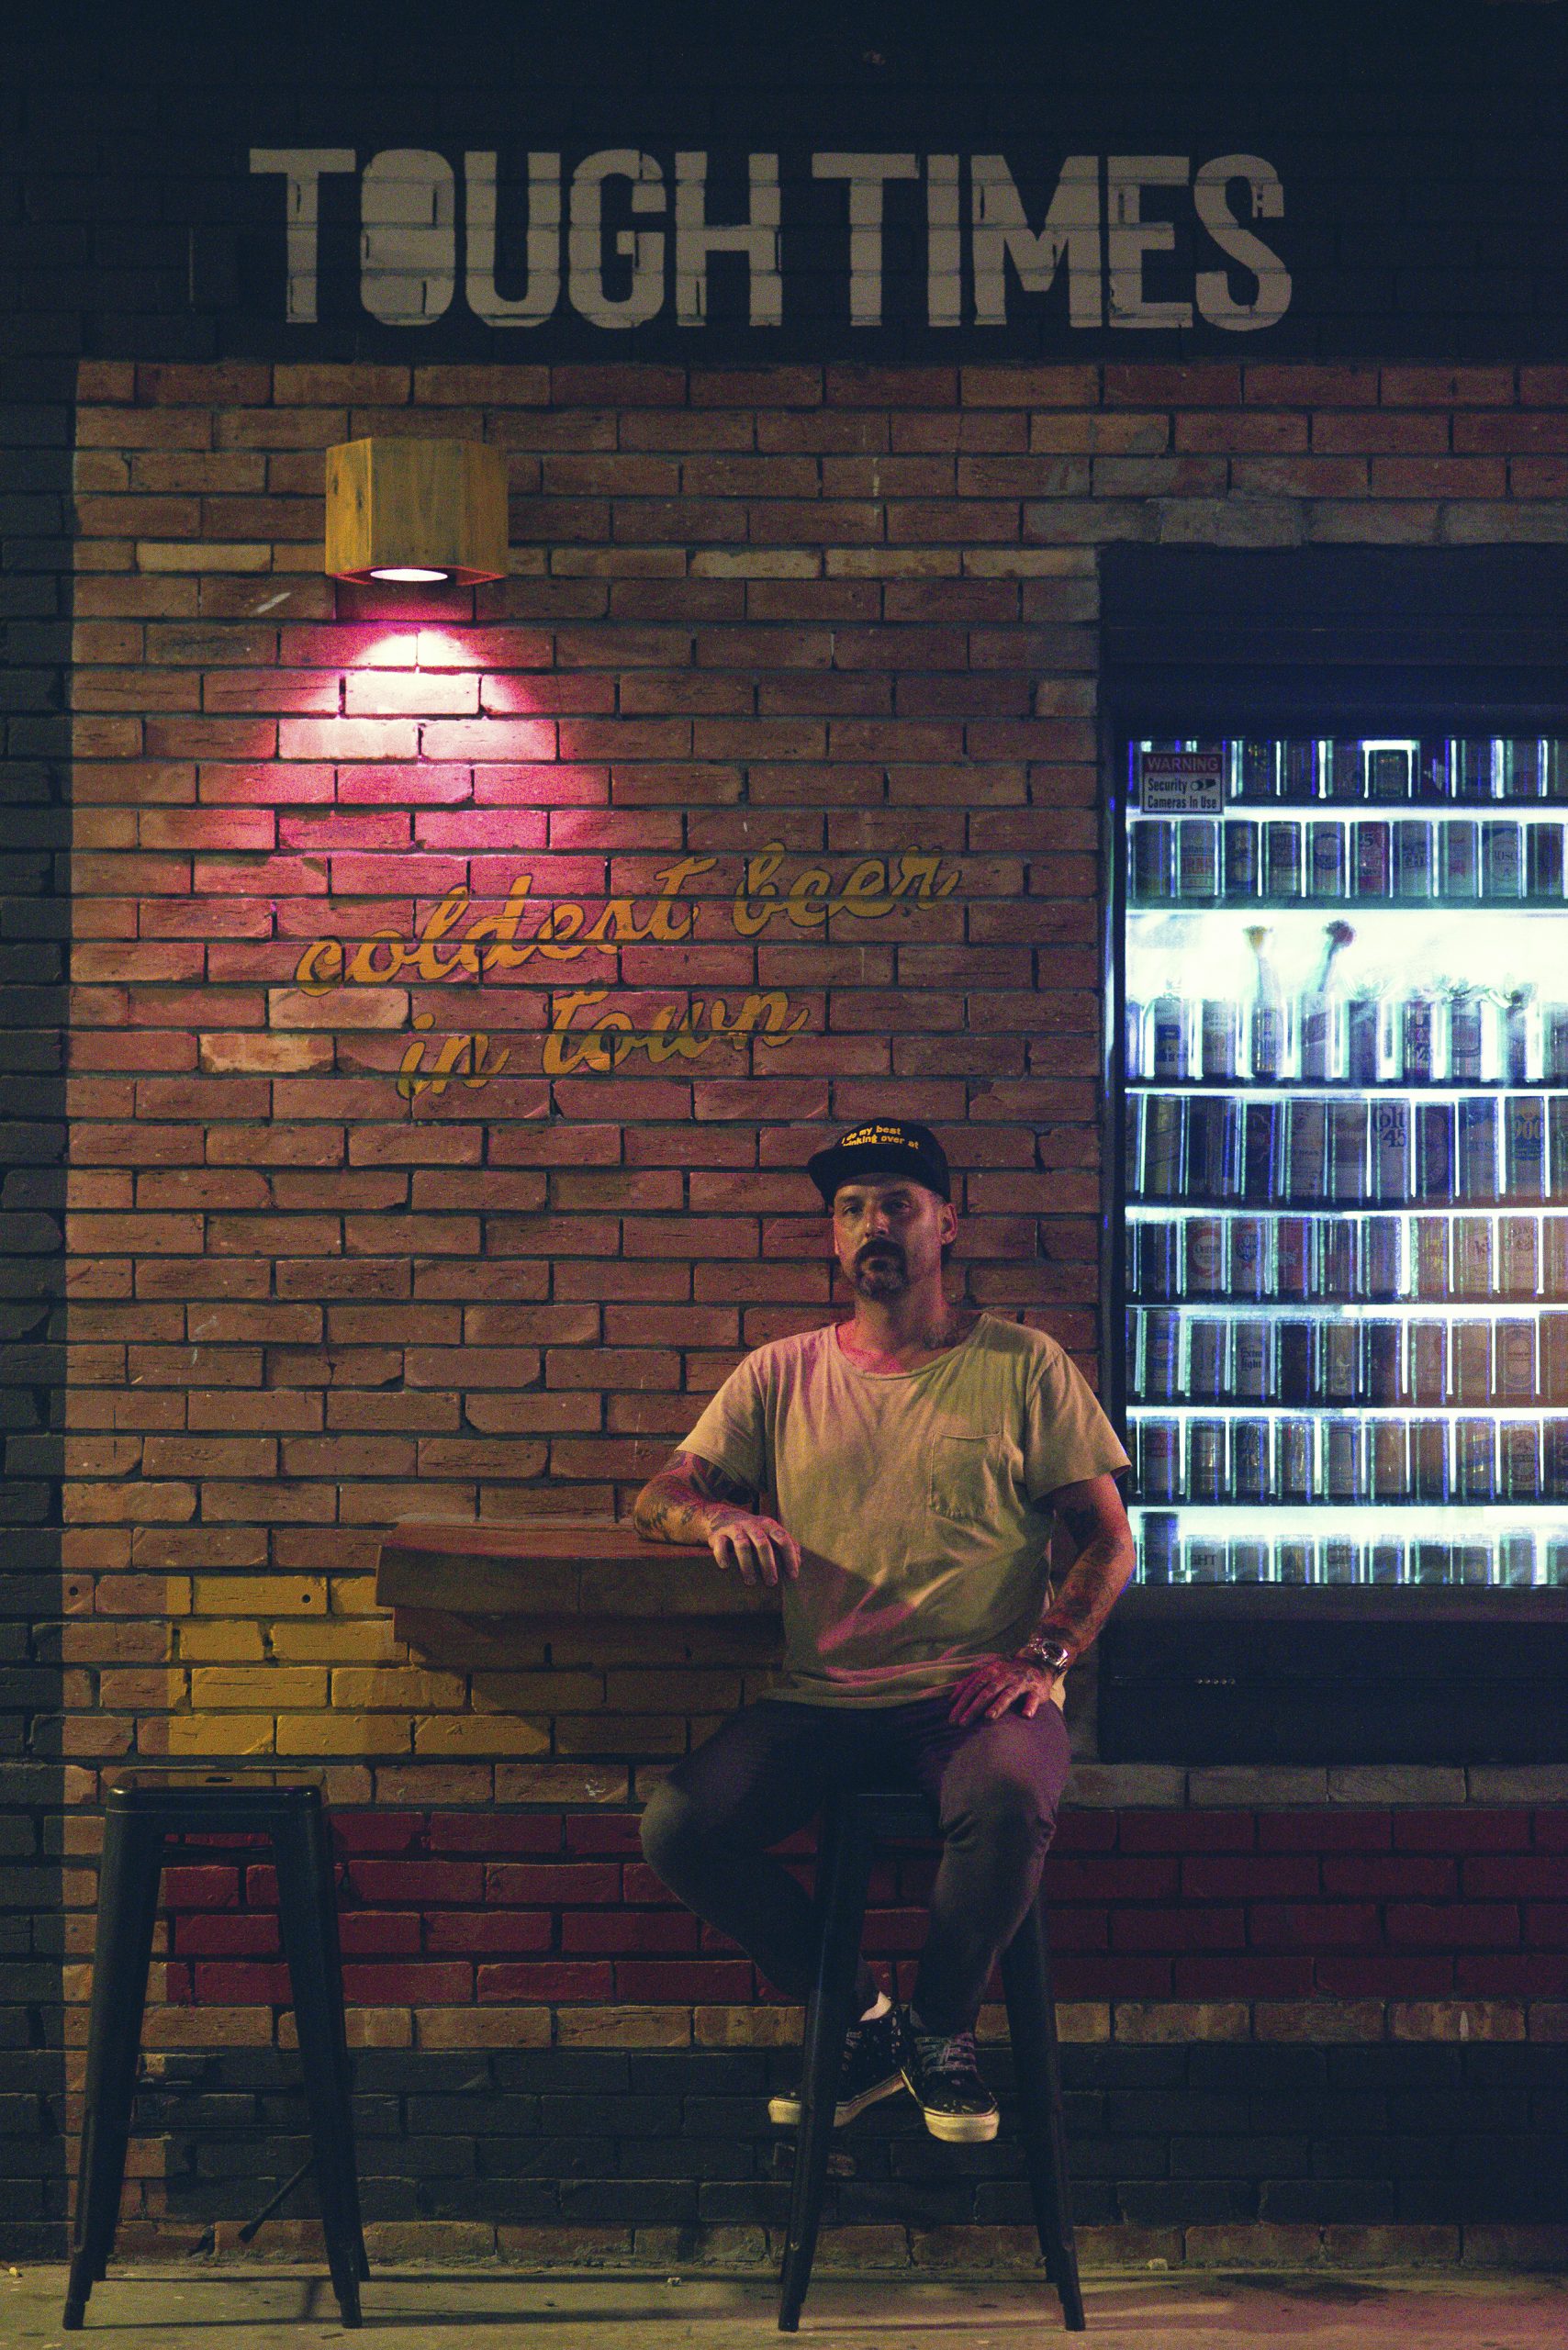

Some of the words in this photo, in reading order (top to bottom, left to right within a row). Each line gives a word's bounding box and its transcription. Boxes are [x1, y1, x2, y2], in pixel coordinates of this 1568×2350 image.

[249, 148, 783, 328] TOUGH
[811, 152, 1293, 331] TIMES
[1147, 757, 1219, 771] WARNING
[1148, 778, 1188, 794] Security
[1148, 795, 1187, 808] Cameras
[1190, 796, 1198, 808] In
[1201, 796, 1217, 809] Use
[294, 856, 718, 996] coldest
[734, 842, 962, 936] beer
[397, 1012, 509, 1100] in
[542, 989, 812, 1076] town
[859, 1127, 872, 1136] my
[876, 1125, 901, 1135] best
[881, 1136, 904, 1144] over
